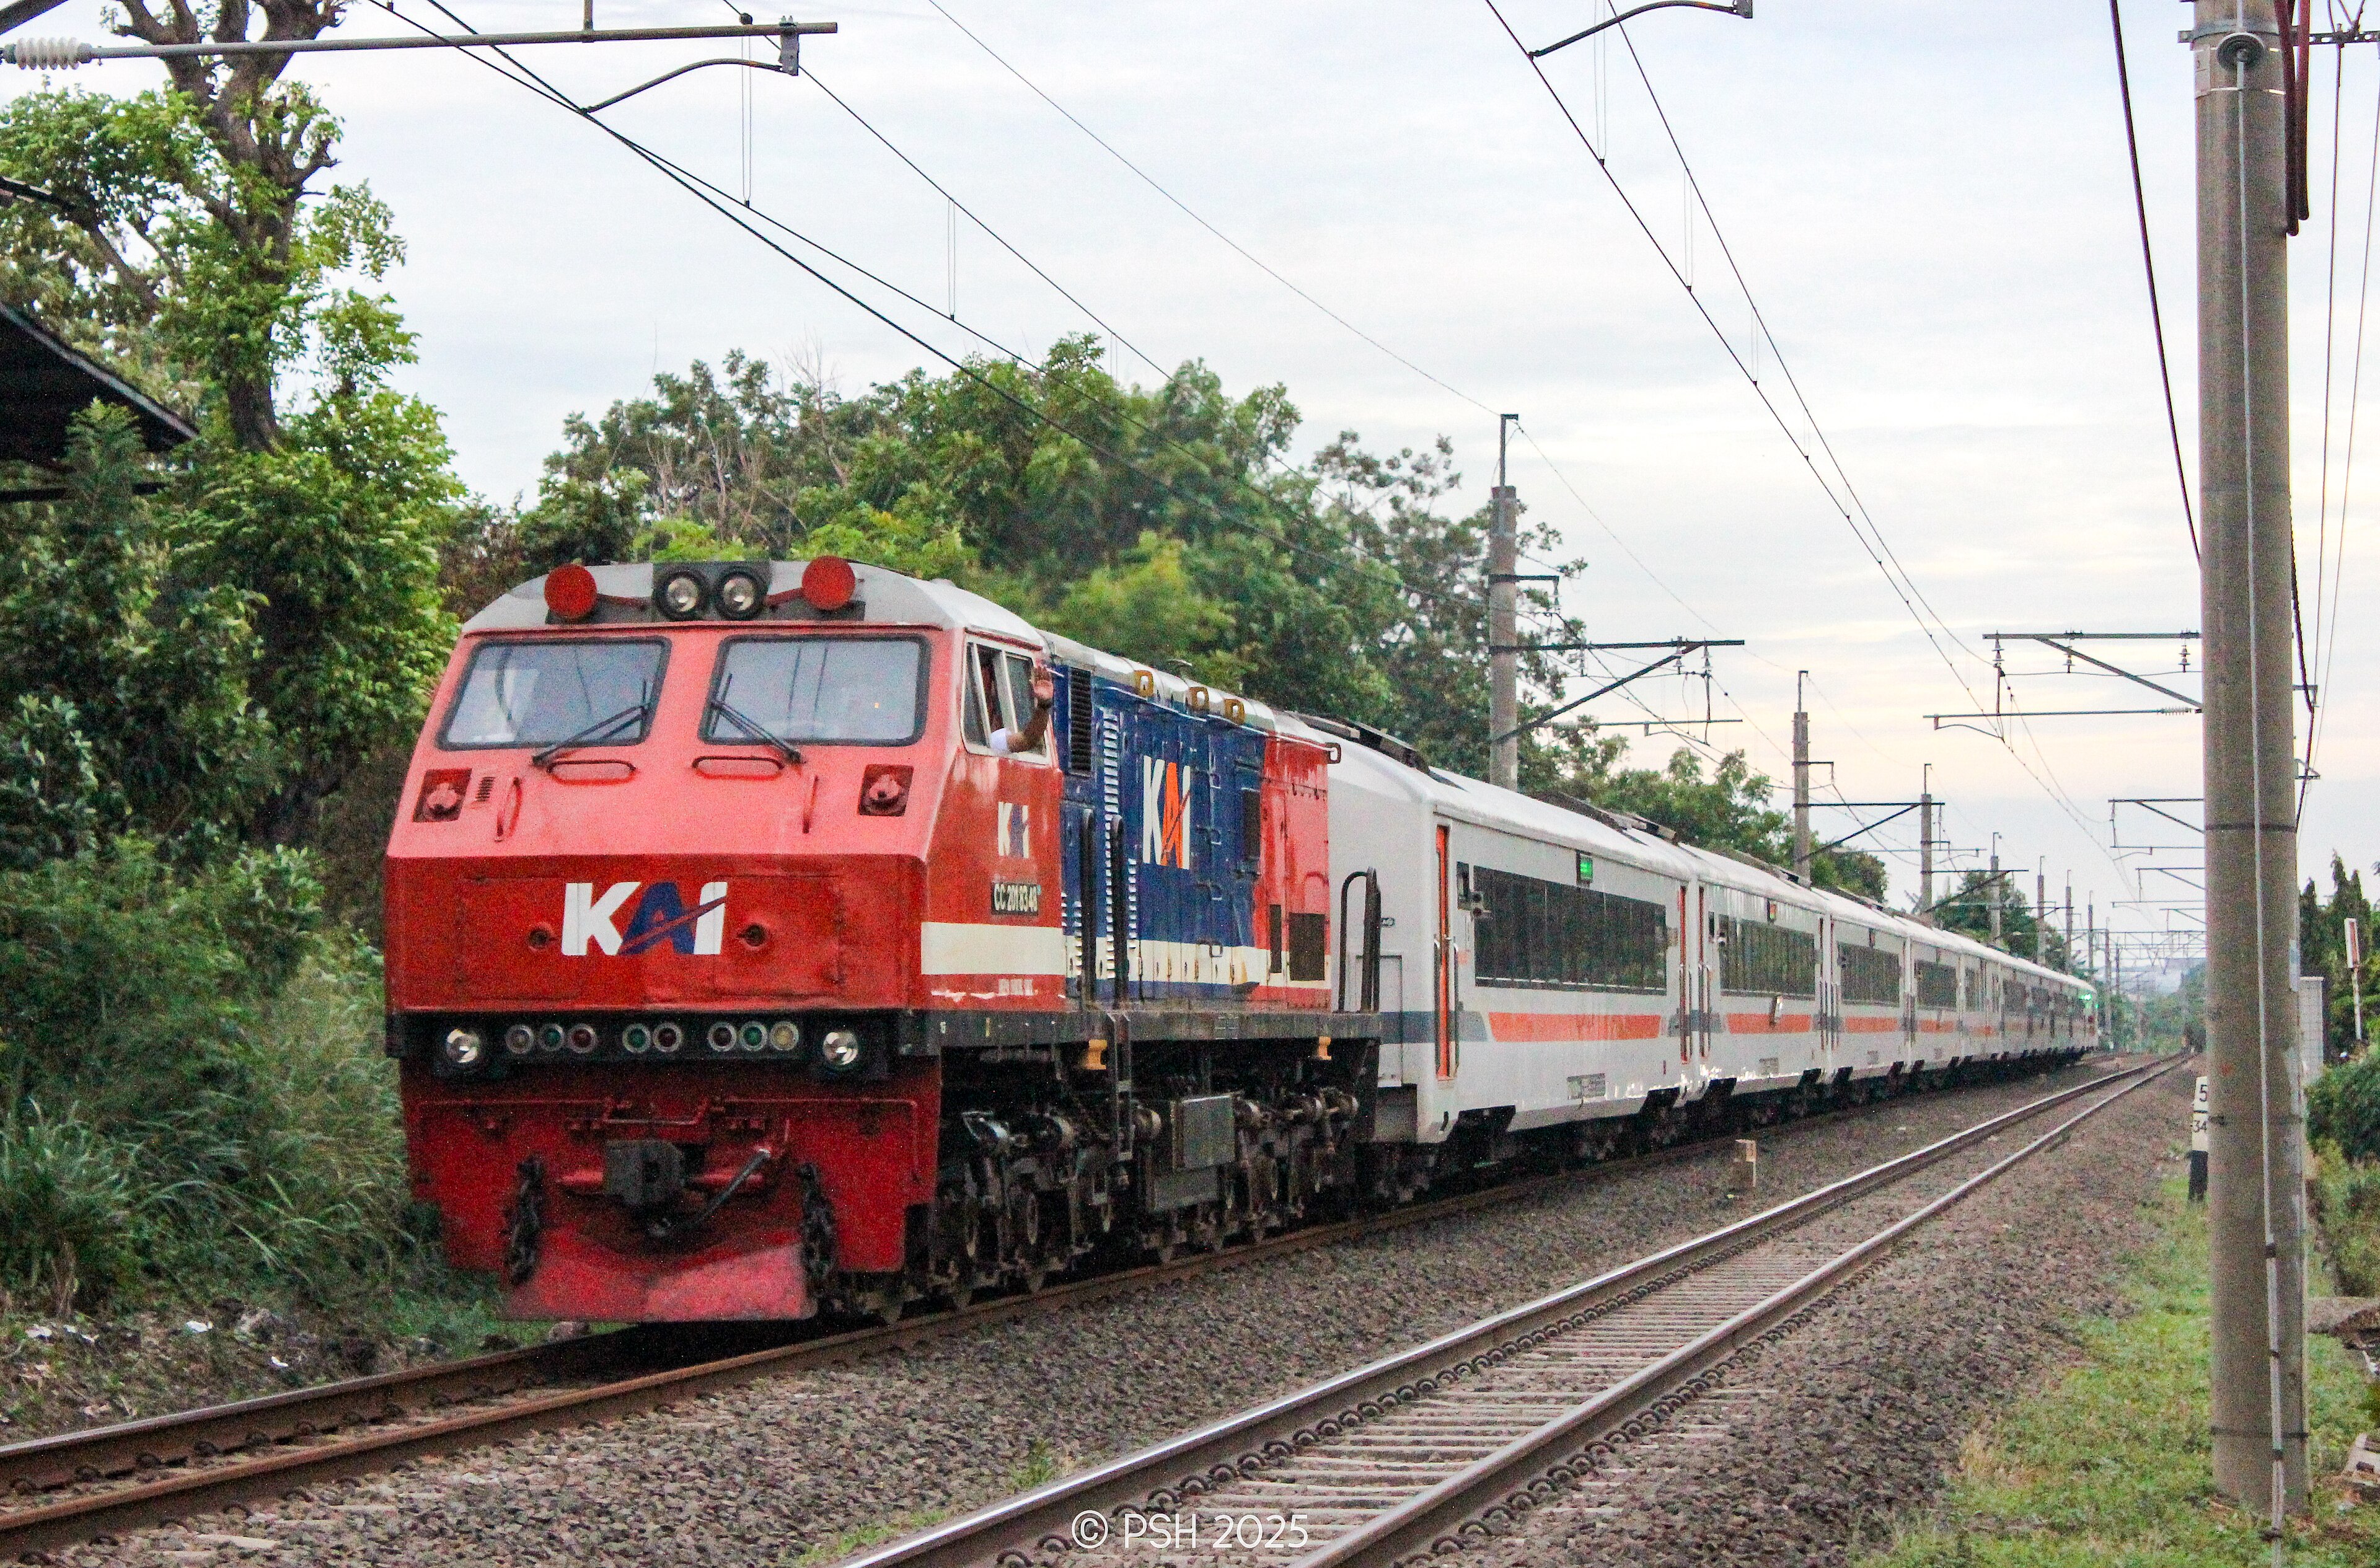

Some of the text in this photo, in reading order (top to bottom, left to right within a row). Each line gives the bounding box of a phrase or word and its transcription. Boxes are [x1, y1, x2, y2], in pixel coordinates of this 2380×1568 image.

[1143, 755, 1191, 870] KAI
[560, 881, 728, 957] KAI
[994, 884, 1006, 911] CC
